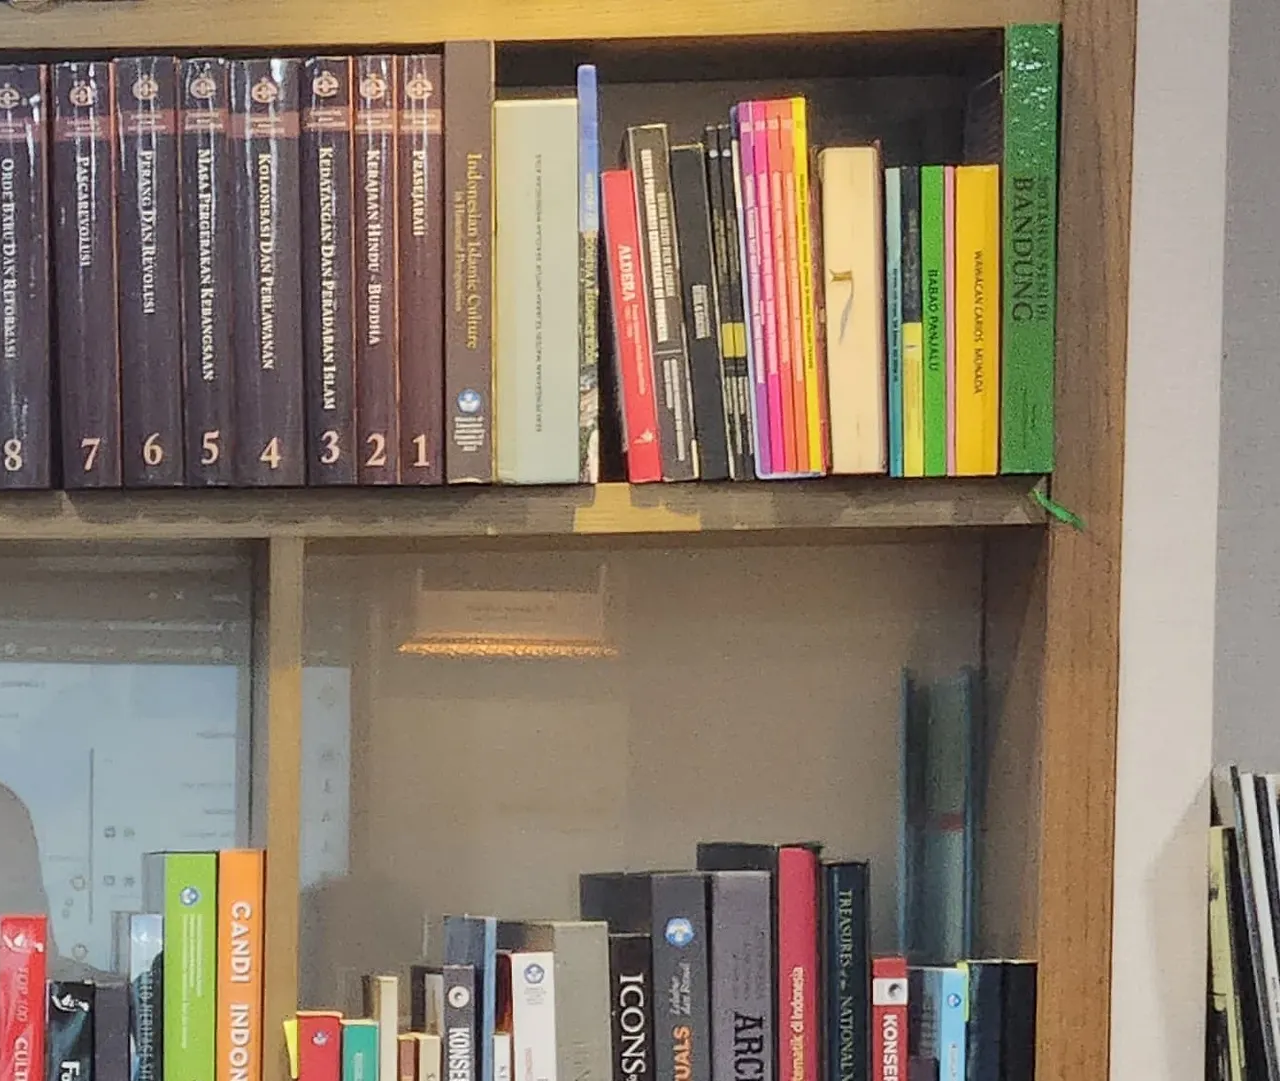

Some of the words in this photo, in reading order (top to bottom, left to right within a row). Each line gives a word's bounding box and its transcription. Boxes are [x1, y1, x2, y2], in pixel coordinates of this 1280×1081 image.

[1, 158, 16, 200] ORDE
[139, 150, 155, 207] PERANG
[197, 149, 213, 190] MASA
[257, 154, 273, 238] KOLONISASI
[318, 147, 334, 242] KEDATANGAN
[366, 150, 381, 220] KERAJAAN
[411, 149, 427, 236] PRASEJARAH
[466, 153, 482, 237] Indonesian
[77, 156, 93, 267] PASCAREVOLUSI
[140, 209, 156, 242] DAN
[198, 193, 213, 284] PERGERAKAN
[1, 243, 17, 276] DAN
[259, 242, 274, 274] DAN
[320, 245, 335, 277] DAN
[366, 224, 381, 271] HINDU
[466, 241, 482, 292] Islamic
[616, 244, 636, 302] ALDERA
[1011, 178, 1035, 322] BANDUNG
[141, 246, 157, 314] REVOLUSI
[926, 269, 940, 313] BABAD
[972, 250, 985, 304] WAWACAN
[2, 279, 18, 359] REFORMASI
[200, 288, 216, 381] KEBANGSAAN
[260, 276, 276, 369] PERLAWANAN
[321, 280, 336, 363] PERADABAN
[366, 284, 382, 345] BUDDHA
[466, 294, 482, 349] Culture
[926, 315, 941, 372] PANJALU
[322, 366, 337, 410] ISLAM
[4, 439, 23, 471] 8
[81, 437, 100, 471] 7
[142, 435, 163, 466] 6
[200, 431, 220, 464] 5
[259, 437, 282, 469] 4
[320, 430, 341, 464] 3
[365, 434, 387, 466] 2
[413, 434, 430, 467] 1
[230, 900, 251, 982] CANDI
[838, 889, 853, 968] TREASURES
[618, 973, 645, 1073] ICONS
[790, 1023, 805, 1033] di
[839, 995, 854, 1072] NATIONAL
[791, 1034, 805, 1081] tematik
